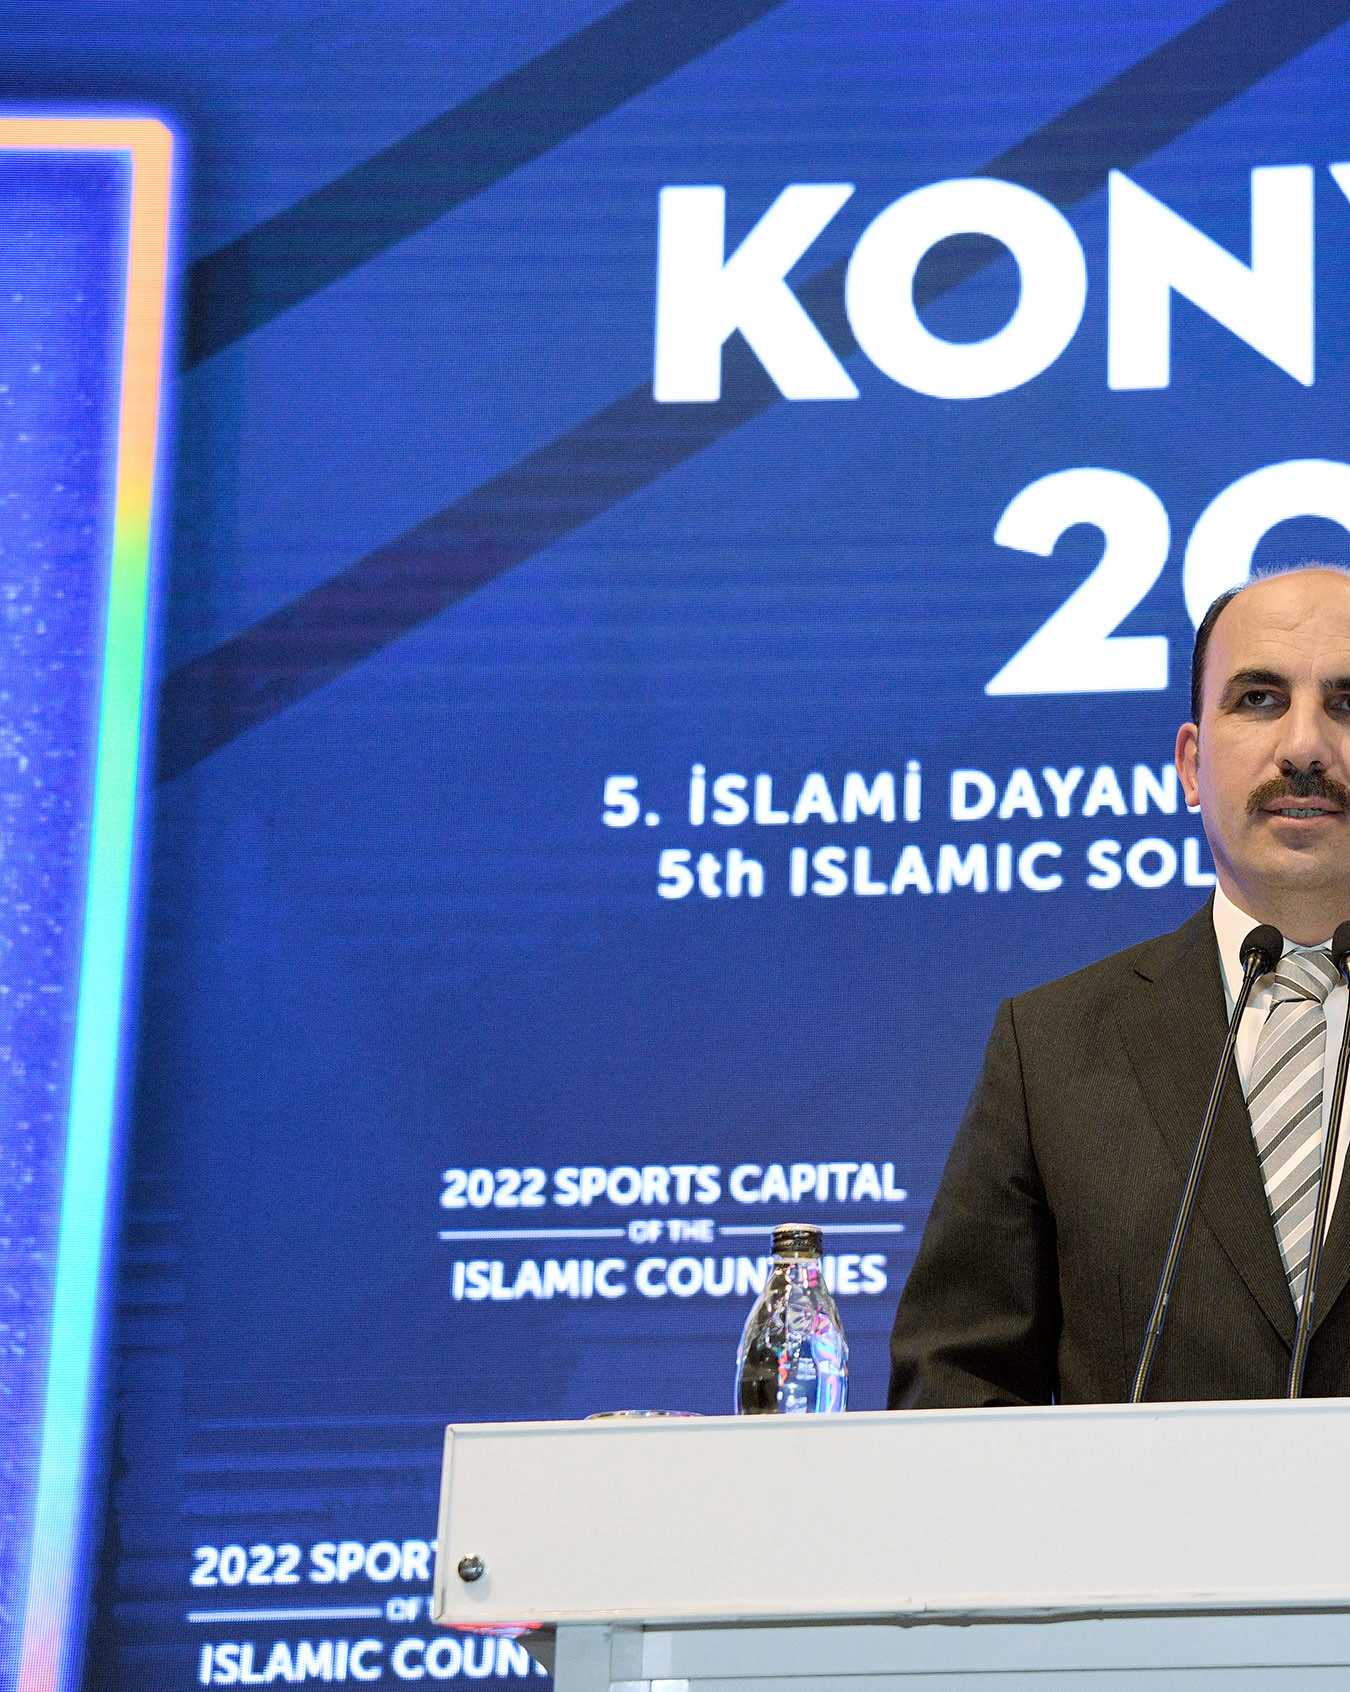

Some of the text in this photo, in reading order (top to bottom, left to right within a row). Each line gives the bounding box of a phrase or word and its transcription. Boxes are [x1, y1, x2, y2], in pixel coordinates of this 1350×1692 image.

[602, 775, 660, 827] 5.
[690, 761, 921, 825] İSLAMİ
[950, 763, 1200, 821] DAYAN
[657, 848, 764, 898] 5th
[790, 840, 1062, 896] ISLAMIC
[441, 1163, 908, 1208] 2022 SPORTS CAPITAL
[628, 1219, 714, 1244] OF THE
[452, 1254, 888, 1300] ISLAMIC COUNIES
[191, 1544, 301, 1587] 2022
[198, 1636, 547, 1685] ISLAMIC COUN
